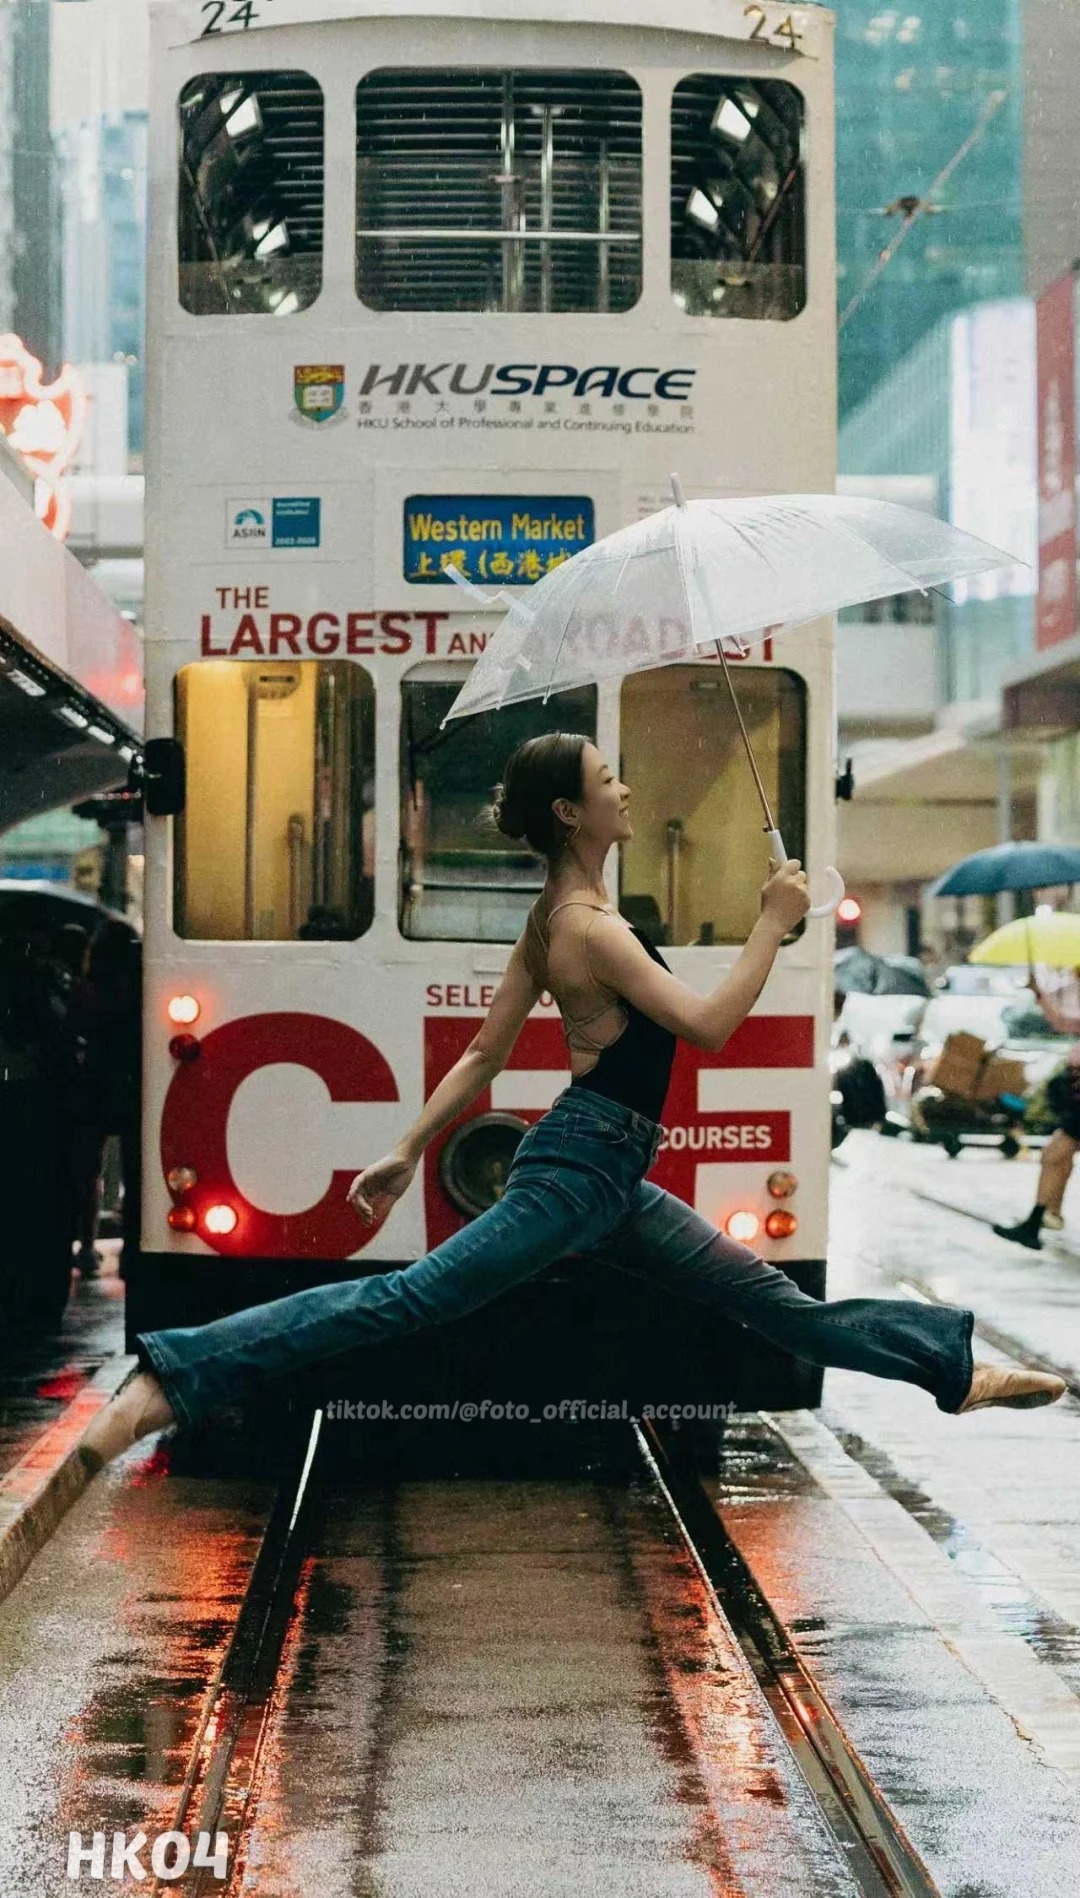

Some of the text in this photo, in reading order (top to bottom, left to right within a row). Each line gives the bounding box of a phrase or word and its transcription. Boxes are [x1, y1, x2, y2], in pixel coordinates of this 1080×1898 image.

[201, 0, 260, 36] 24
[744, 5, 803, 48] 24
[357, 416, 695, 434] HKU School of Professional and Continuing Education
[409, 513, 586, 542] Western Market
[215, 586, 270, 609] THE
[201, 611, 450, 657] LARGEST
[447, 632, 494, 655] AN
[657, 1124, 773, 1151] COURSES
